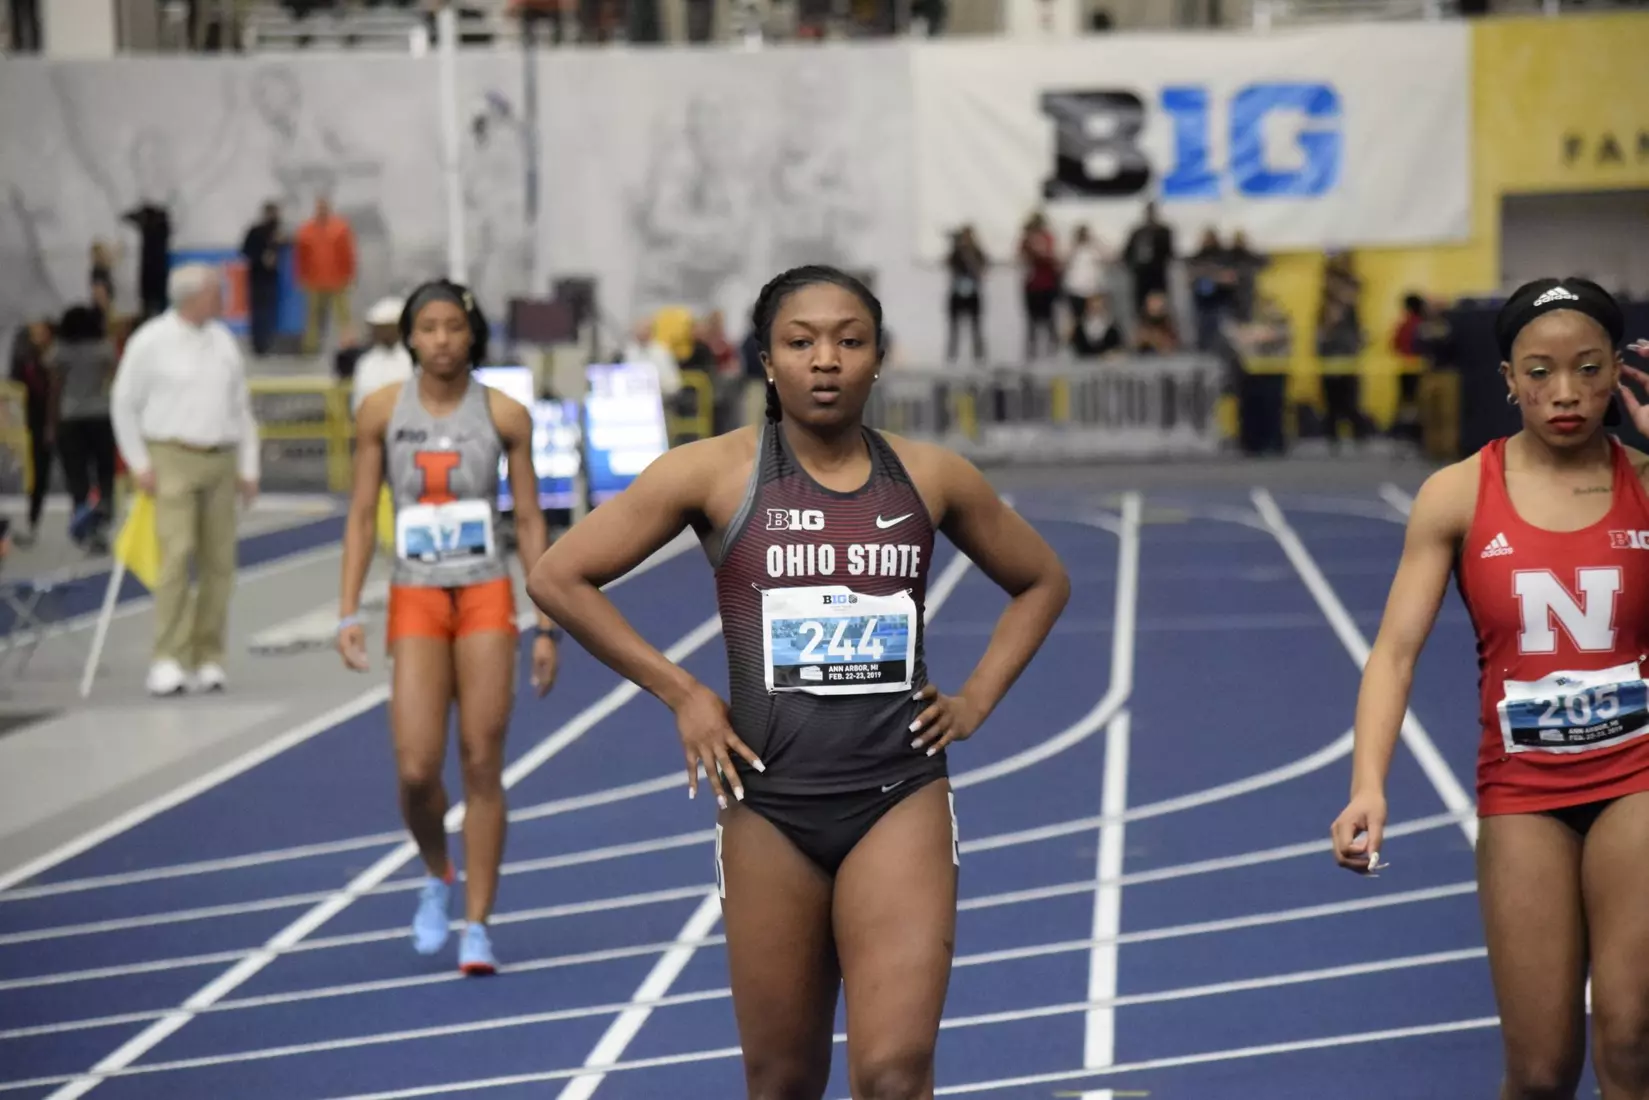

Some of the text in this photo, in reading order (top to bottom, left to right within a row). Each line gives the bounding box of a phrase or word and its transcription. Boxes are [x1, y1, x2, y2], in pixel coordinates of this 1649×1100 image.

[767, 543, 921, 579] OHIO STATE
[1511, 566, 1624, 655] N
[800, 617, 884, 662] 244
[828, 665, 844, 673] ANN
[845, 664, 870, 673] ARBOR,
[828, 671, 882, 681] FEB. 22-23, 2019
[1538, 684, 1619, 726] 205
